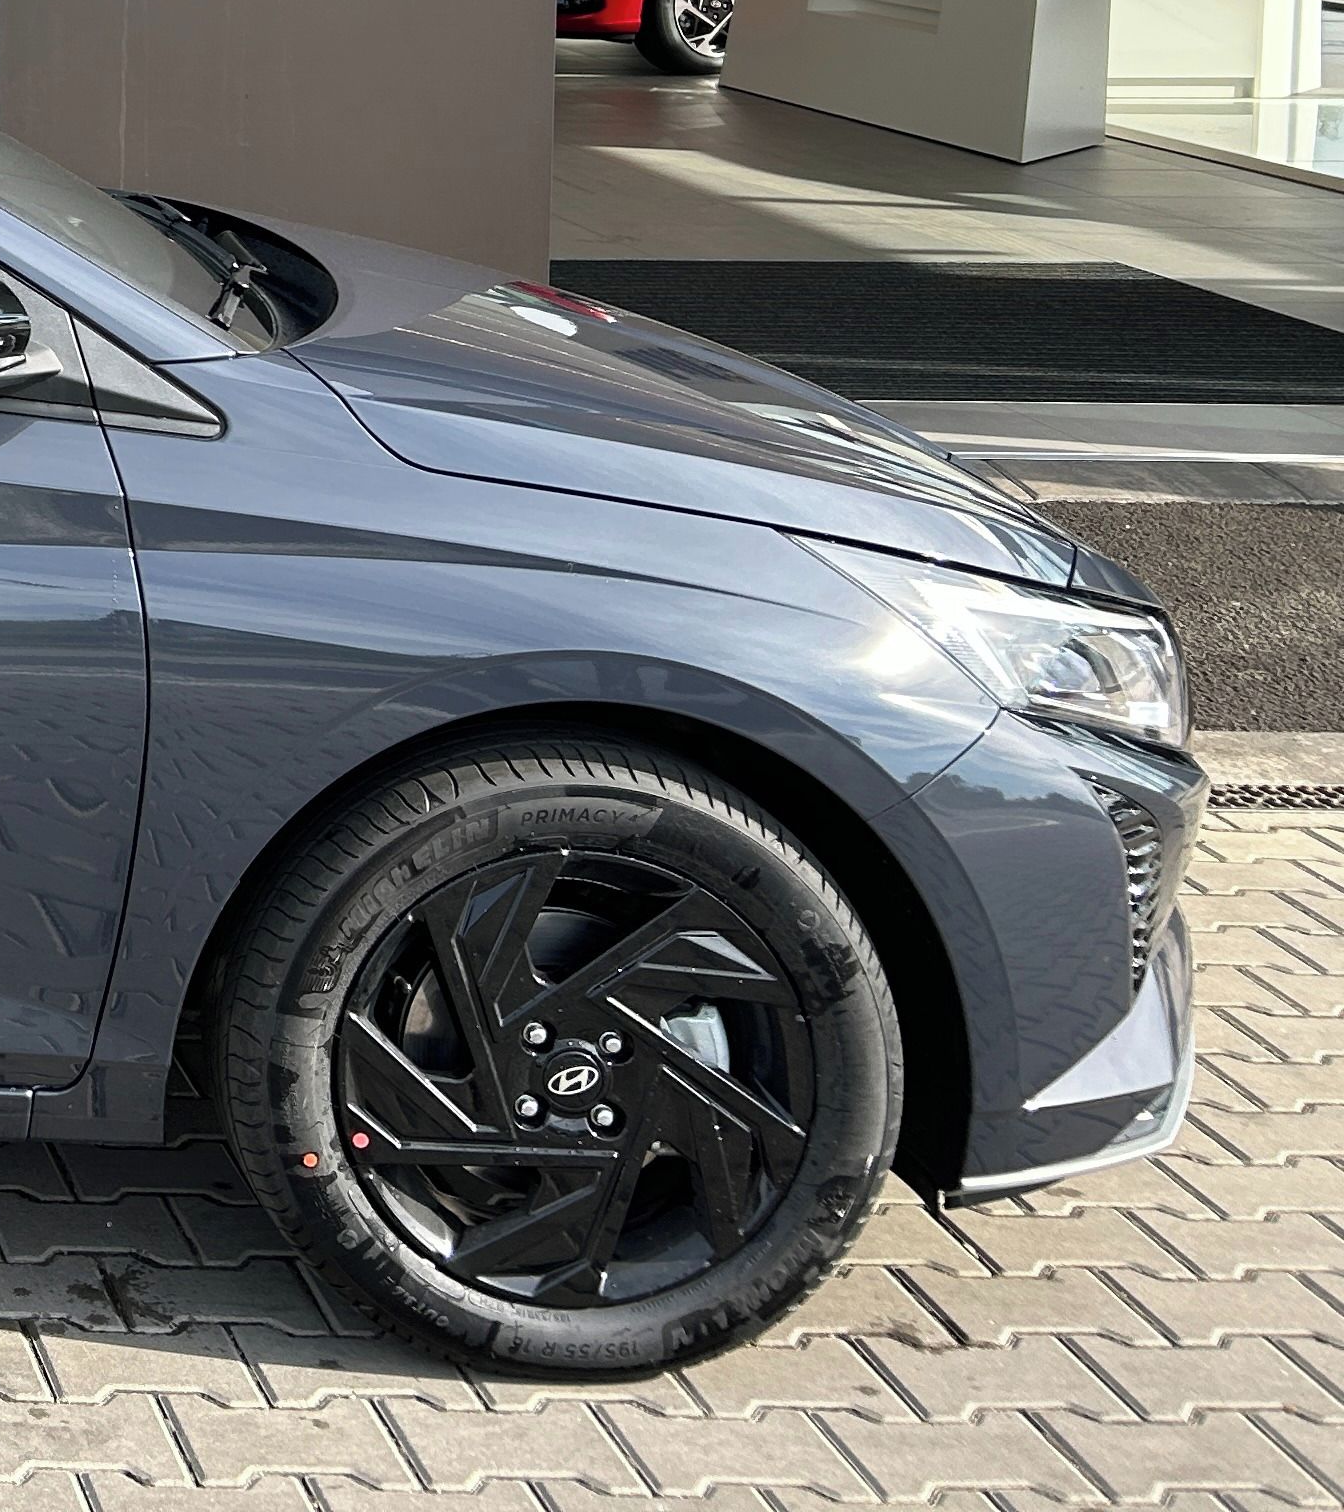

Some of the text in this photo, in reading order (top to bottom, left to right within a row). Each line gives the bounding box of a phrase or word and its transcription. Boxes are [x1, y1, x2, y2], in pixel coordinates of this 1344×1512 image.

[520, 806, 627, 827] PRIMACY
[542, 1341, 557, 1357] R
[564, 1341, 639, 1359] 195/55
